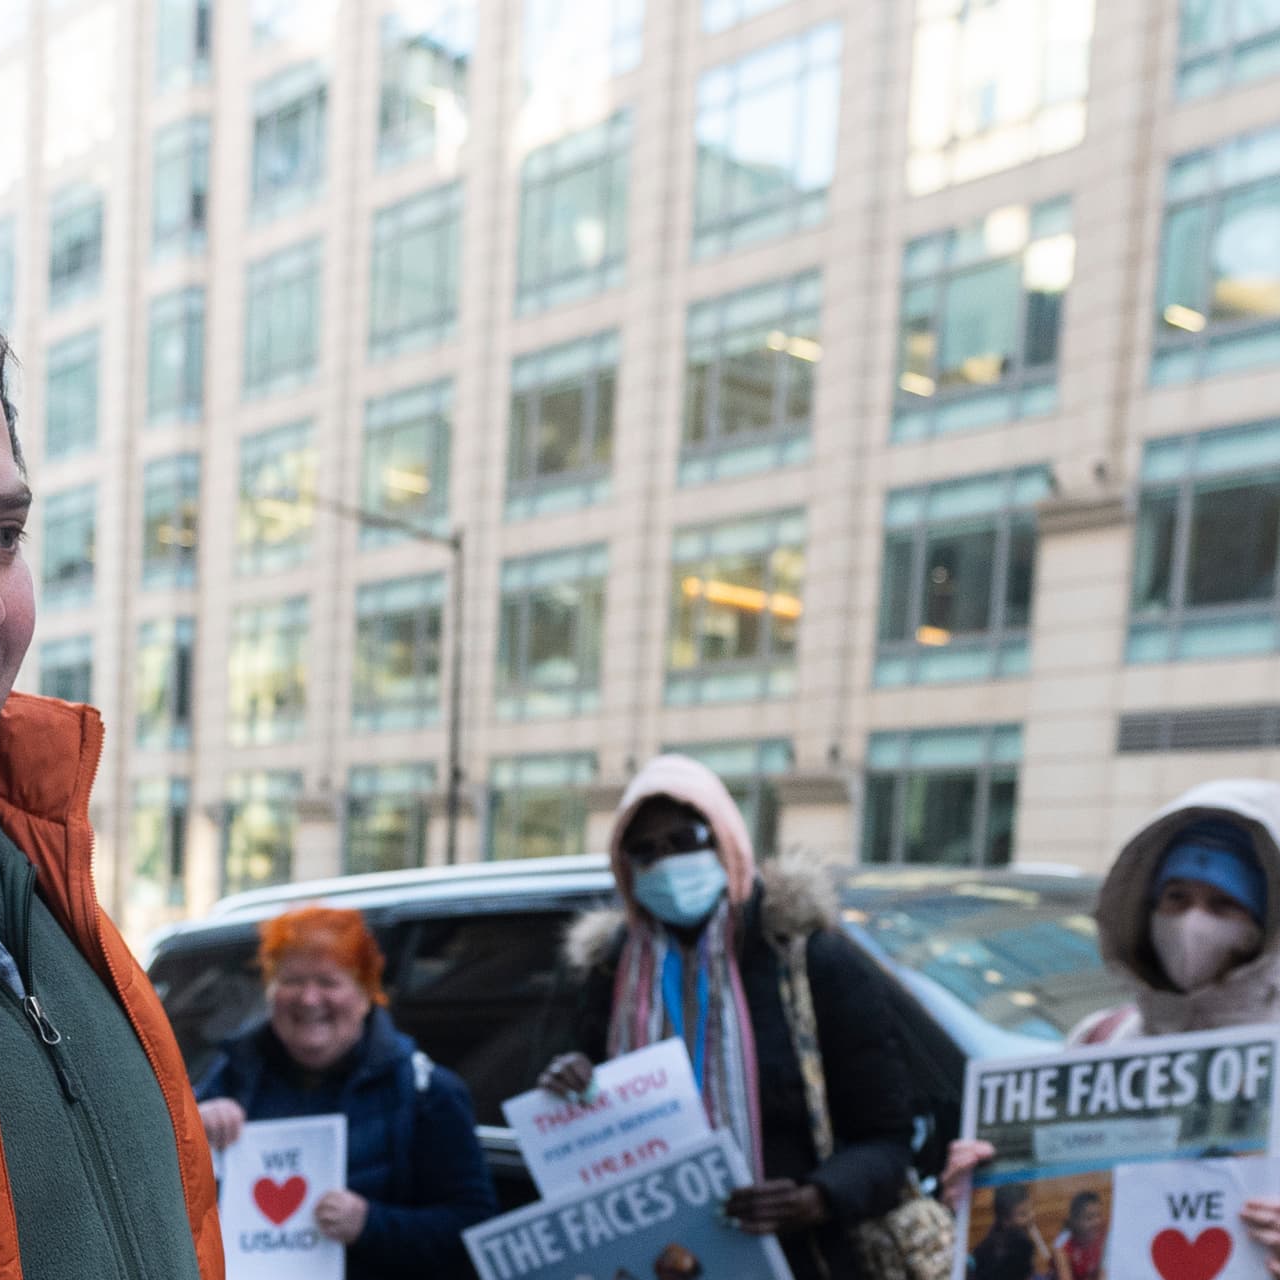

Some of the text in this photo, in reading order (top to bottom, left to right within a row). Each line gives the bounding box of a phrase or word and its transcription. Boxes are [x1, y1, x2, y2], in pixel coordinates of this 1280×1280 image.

[615, 1069, 668, 1099] YOU
[980, 1044, 1272, 1124] THE FACES OF
[262, 1148, 302, 1170] WE
[559, 1174, 676, 1253] FACES
[677, 1151, 732, 1204] OF
[1167, 1191, 1225, 1222] WE
[238, 1228, 318, 1253] USAID
